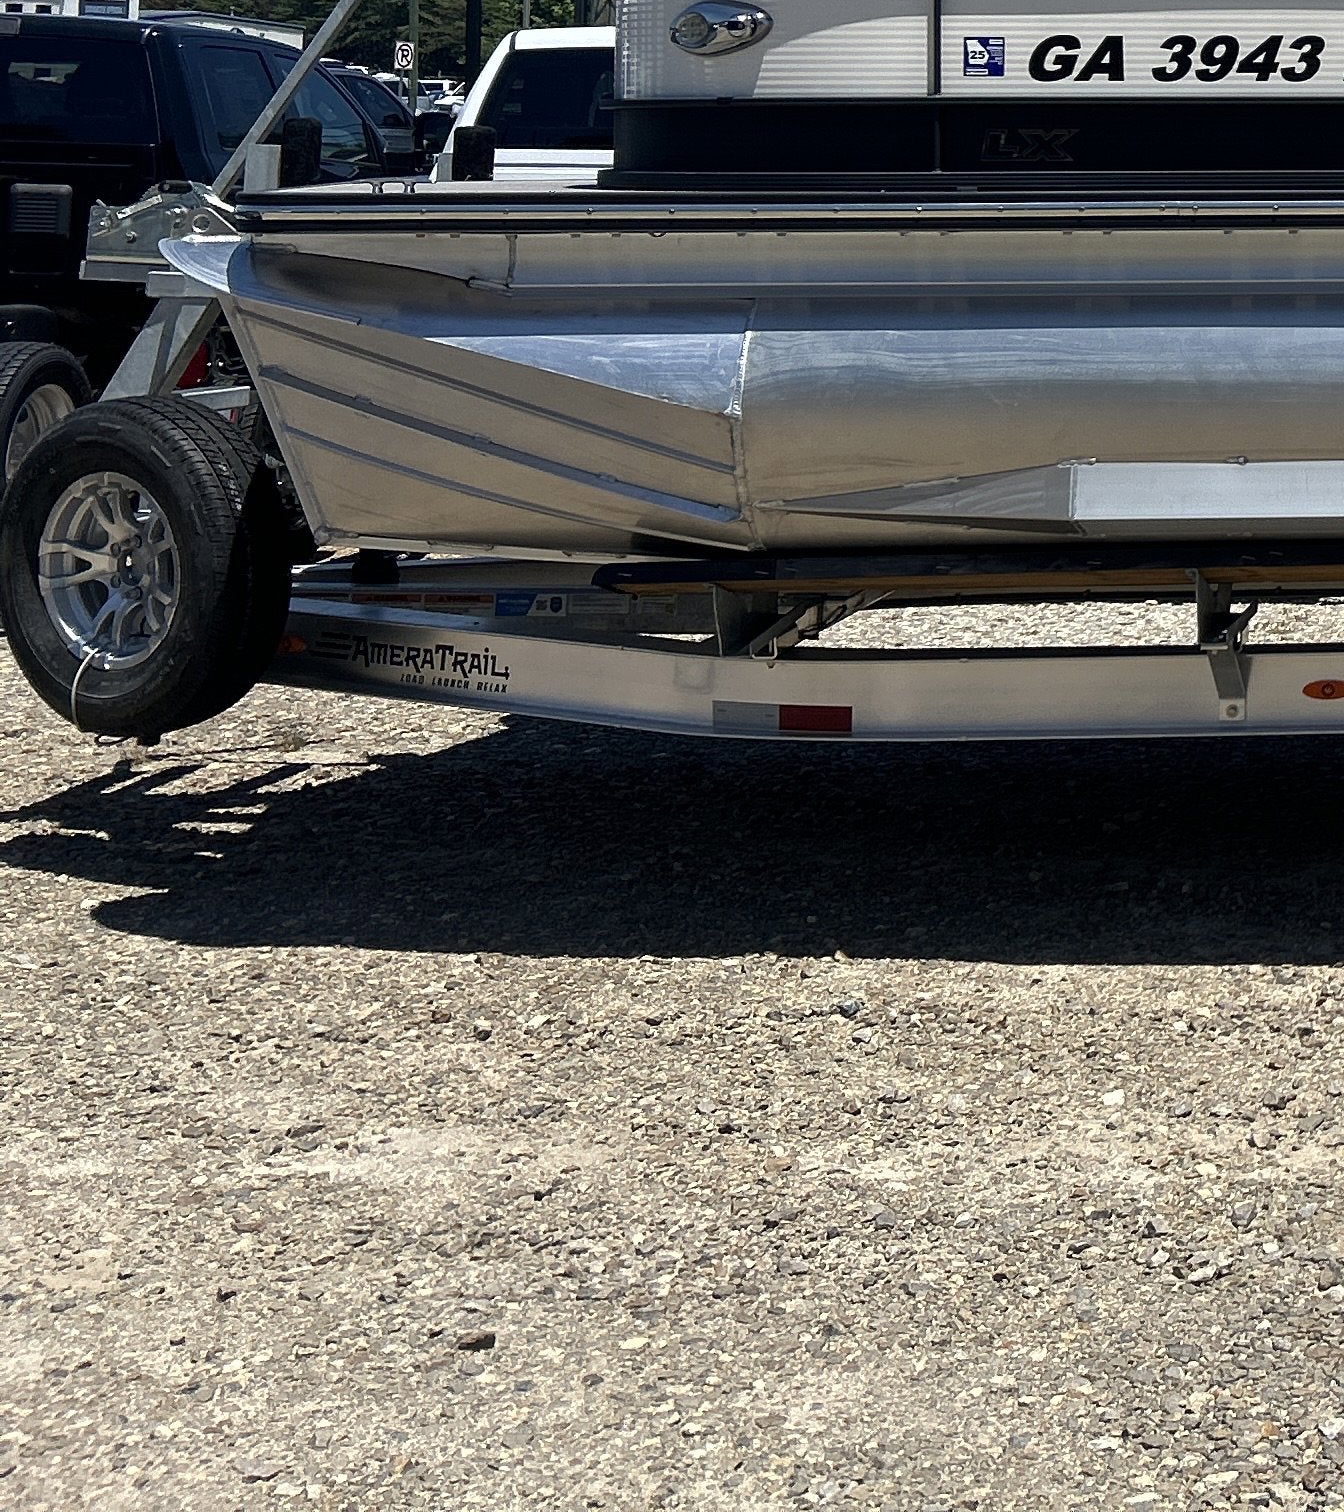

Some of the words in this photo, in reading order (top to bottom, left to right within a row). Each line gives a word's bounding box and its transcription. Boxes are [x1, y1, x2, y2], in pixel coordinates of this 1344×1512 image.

[969, 50, 986, 60] 25
[1027, 34, 1126, 83] GA
[1151, 34, 1325, 83] 3943
[431, 676, 470, 690] LAUNCH
[476, 681, 509, 694] RELAX
